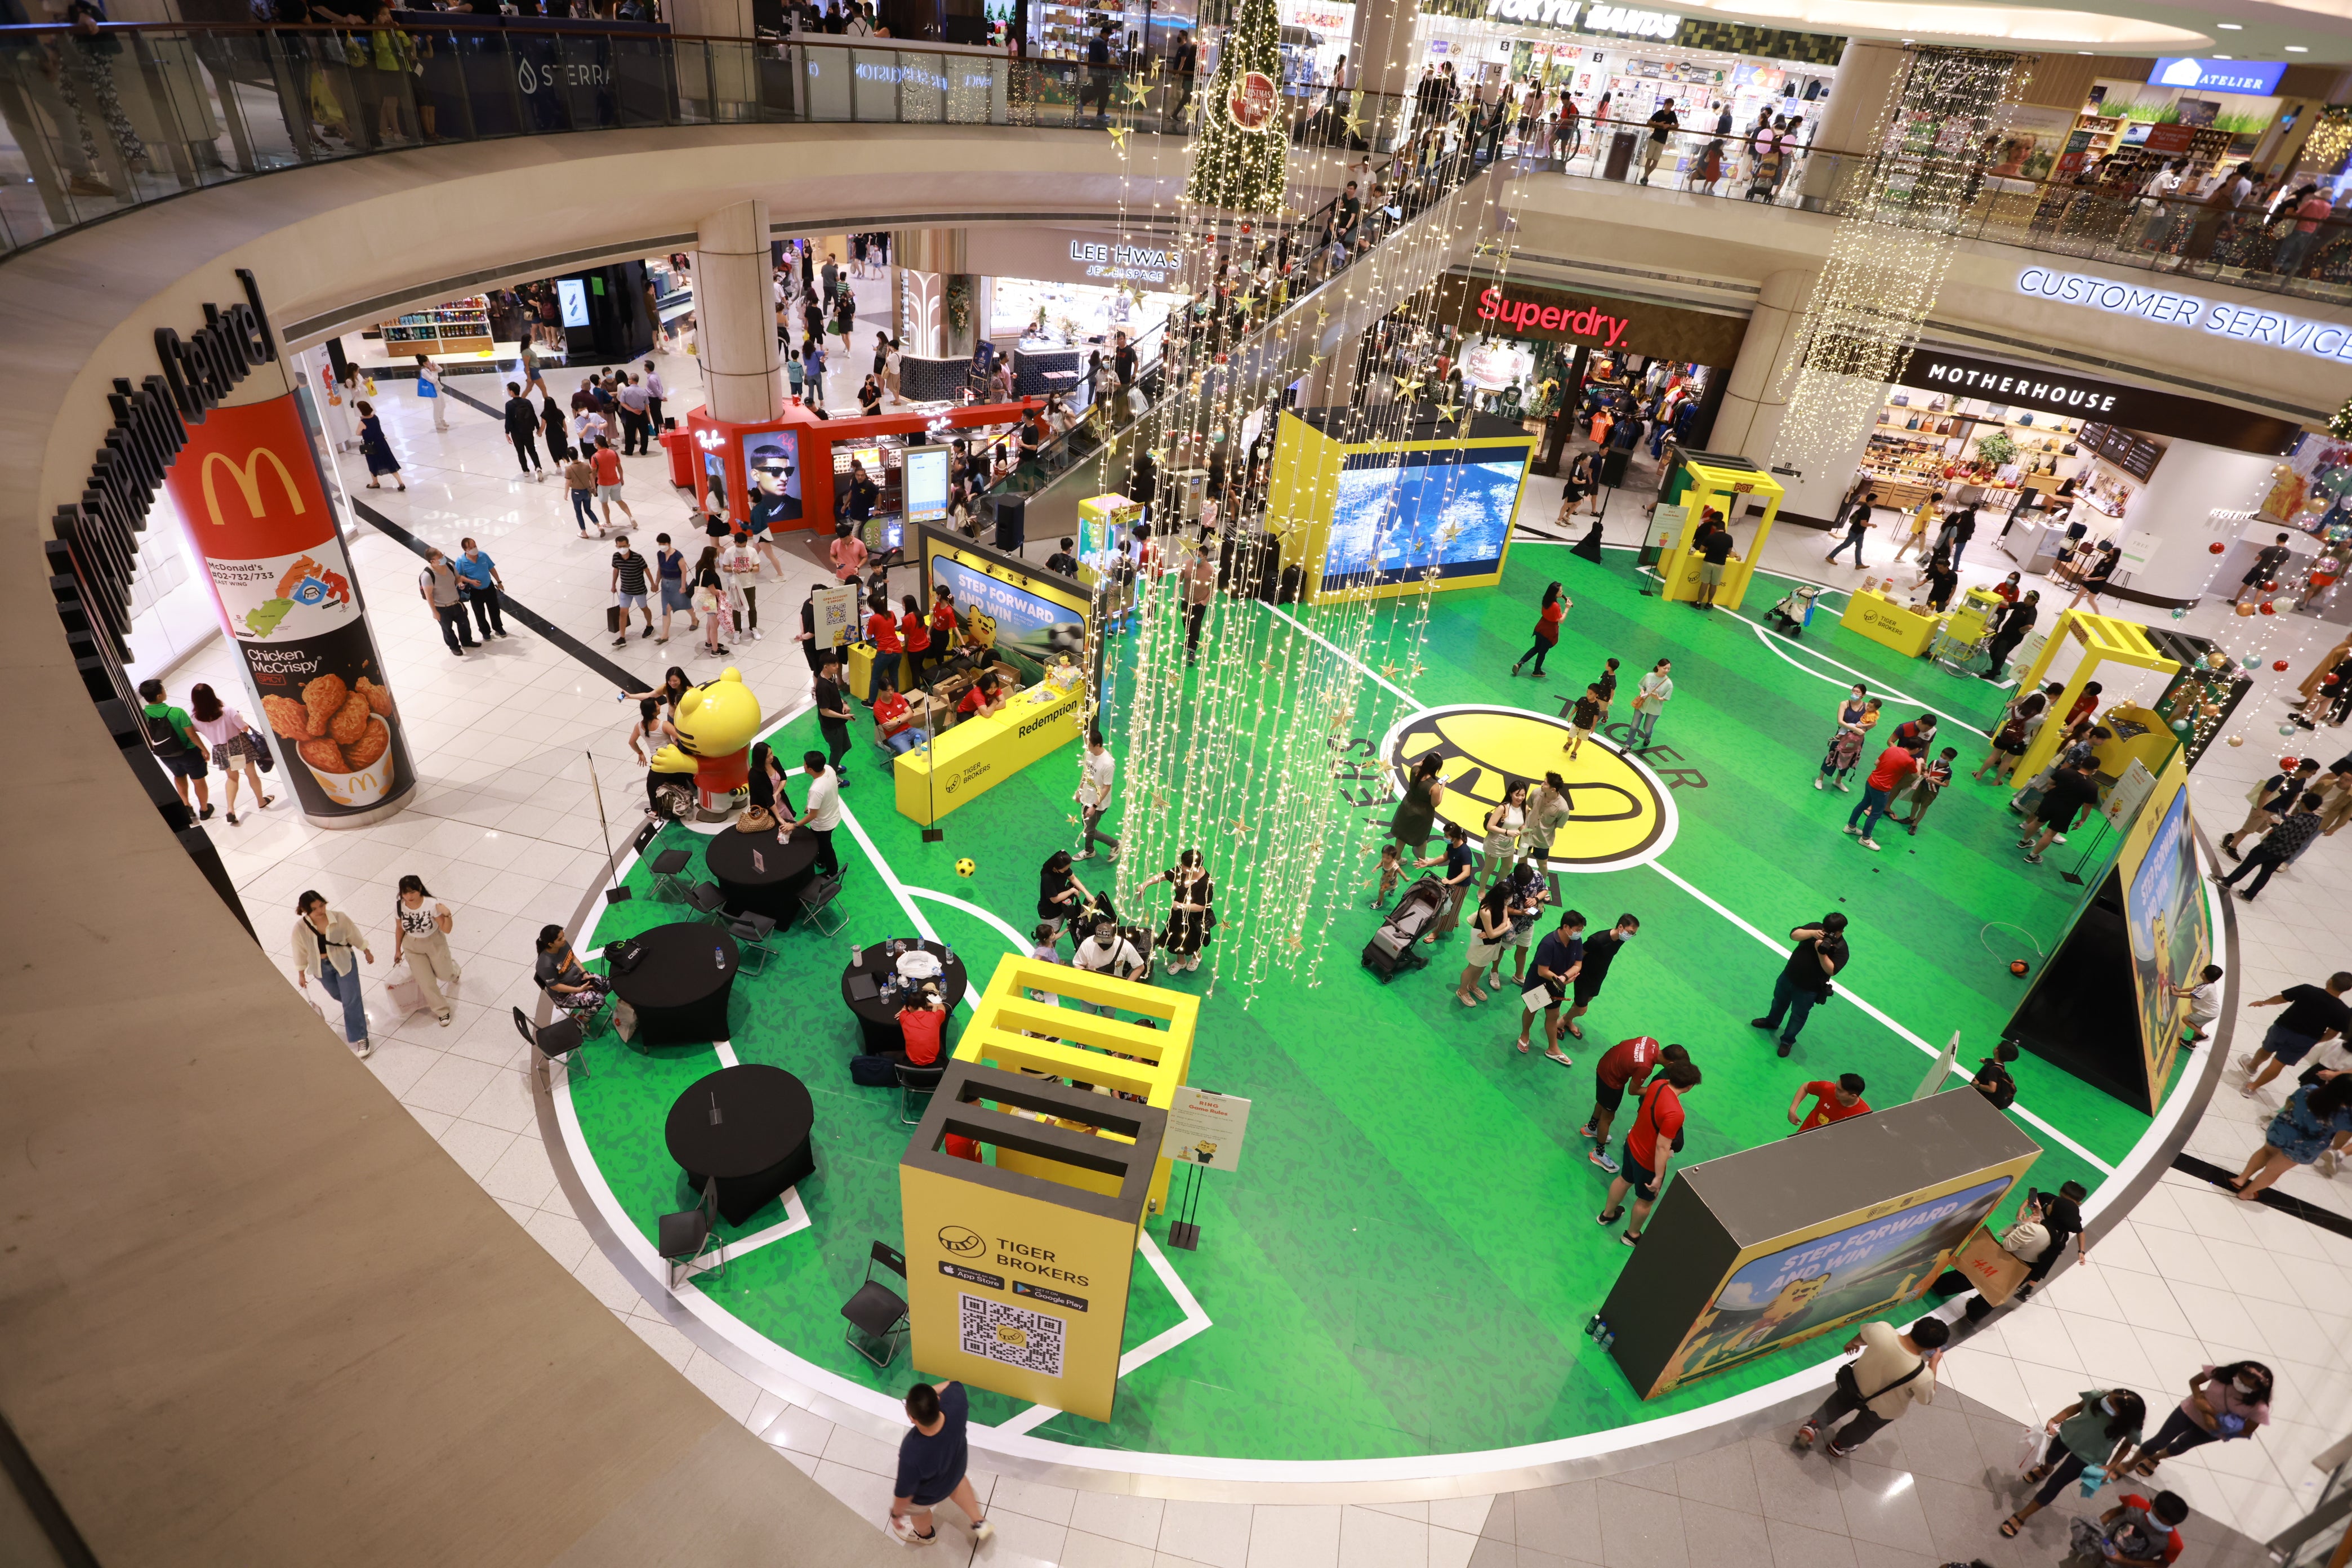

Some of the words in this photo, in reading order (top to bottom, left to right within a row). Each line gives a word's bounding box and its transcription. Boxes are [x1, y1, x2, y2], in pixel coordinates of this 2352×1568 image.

[1584, 5, 1681, 38] HANDS
[2199, 74, 2263, 90] ATELIER
[1072, 242, 1106, 261] LEE
[2020, 270, 2199, 325] CUSTOMER
[1928, 364, 2116, 412] MOTHERHOUSE
[1734, 483, 1753, 493] POT
[208, 563, 263, 572] McDonald's
[212, 572, 274, 581] #02-732/733
[958, 573, 987, 595] STEP
[990, 586, 1054, 623] FORWARD
[958, 590, 985, 610] AND
[986, 600, 1012, 623] WIN
[1878, 621, 1903, 636] BROKERS
[1881, 616, 1897, 626] TIGER
[247, 649, 305, 661] Chicken
[259, 675, 282, 684] SPICY
[1018, 700, 1077, 739] Redemption
[963, 761, 981, 776] TIGER
[963, 764, 991, 784] BROKERS
[2141, 877, 2154, 906] STEP
[2153, 816, 2180, 879] FORWARD
[2144, 895, 2157, 934] AND
[2155, 870, 2168, 906] WIN
[1780, 1241, 1842, 1272] STEP
[1841, 1202, 1958, 1251] FORWARD
[996, 1238, 1056, 1263] TIGER
[957, 1268, 981, 1277] Download
[996, 1254, 1089, 1287] BROKERS
[1765, 1263, 1821, 1293] AND
[1824, 1244, 1874, 1268] WIN
[1972, 1258, 1998, 1277] H&M
[957, 1271, 975, 1281] App
[977, 1276, 1000, 1287] Store
[1035, 1291, 1065, 1304] Google
[1066, 1299, 1084, 1310] Play
